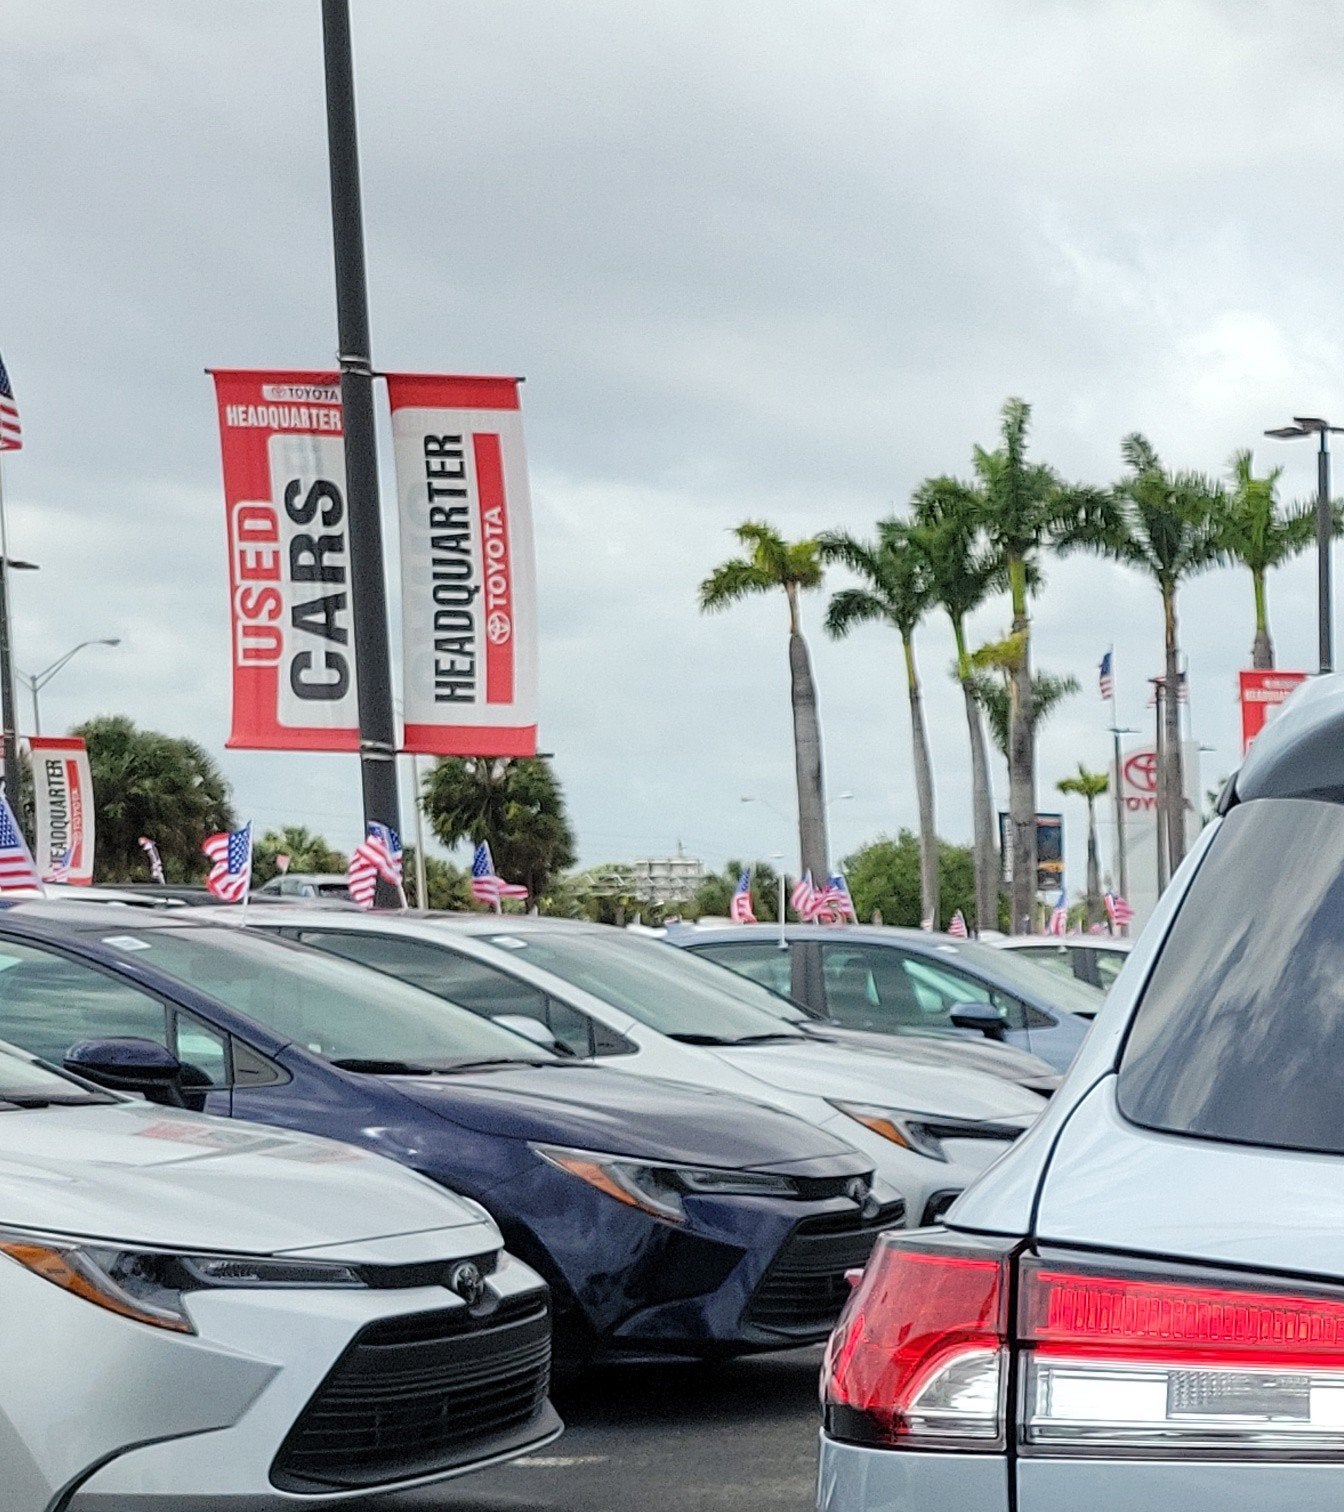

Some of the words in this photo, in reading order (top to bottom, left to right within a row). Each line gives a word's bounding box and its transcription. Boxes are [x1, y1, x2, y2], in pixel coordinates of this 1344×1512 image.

[226, 405, 342, 431] HEADQUARTER
[288, 387, 338, 400] TOYOTA
[237, 505, 283, 663] USED
[284, 478, 350, 701] CARS
[424, 433, 481, 703] HEADQUARTER
[486, 506, 509, 607] TOYOTA
[45, 758, 68, 868] EADQUARTER
